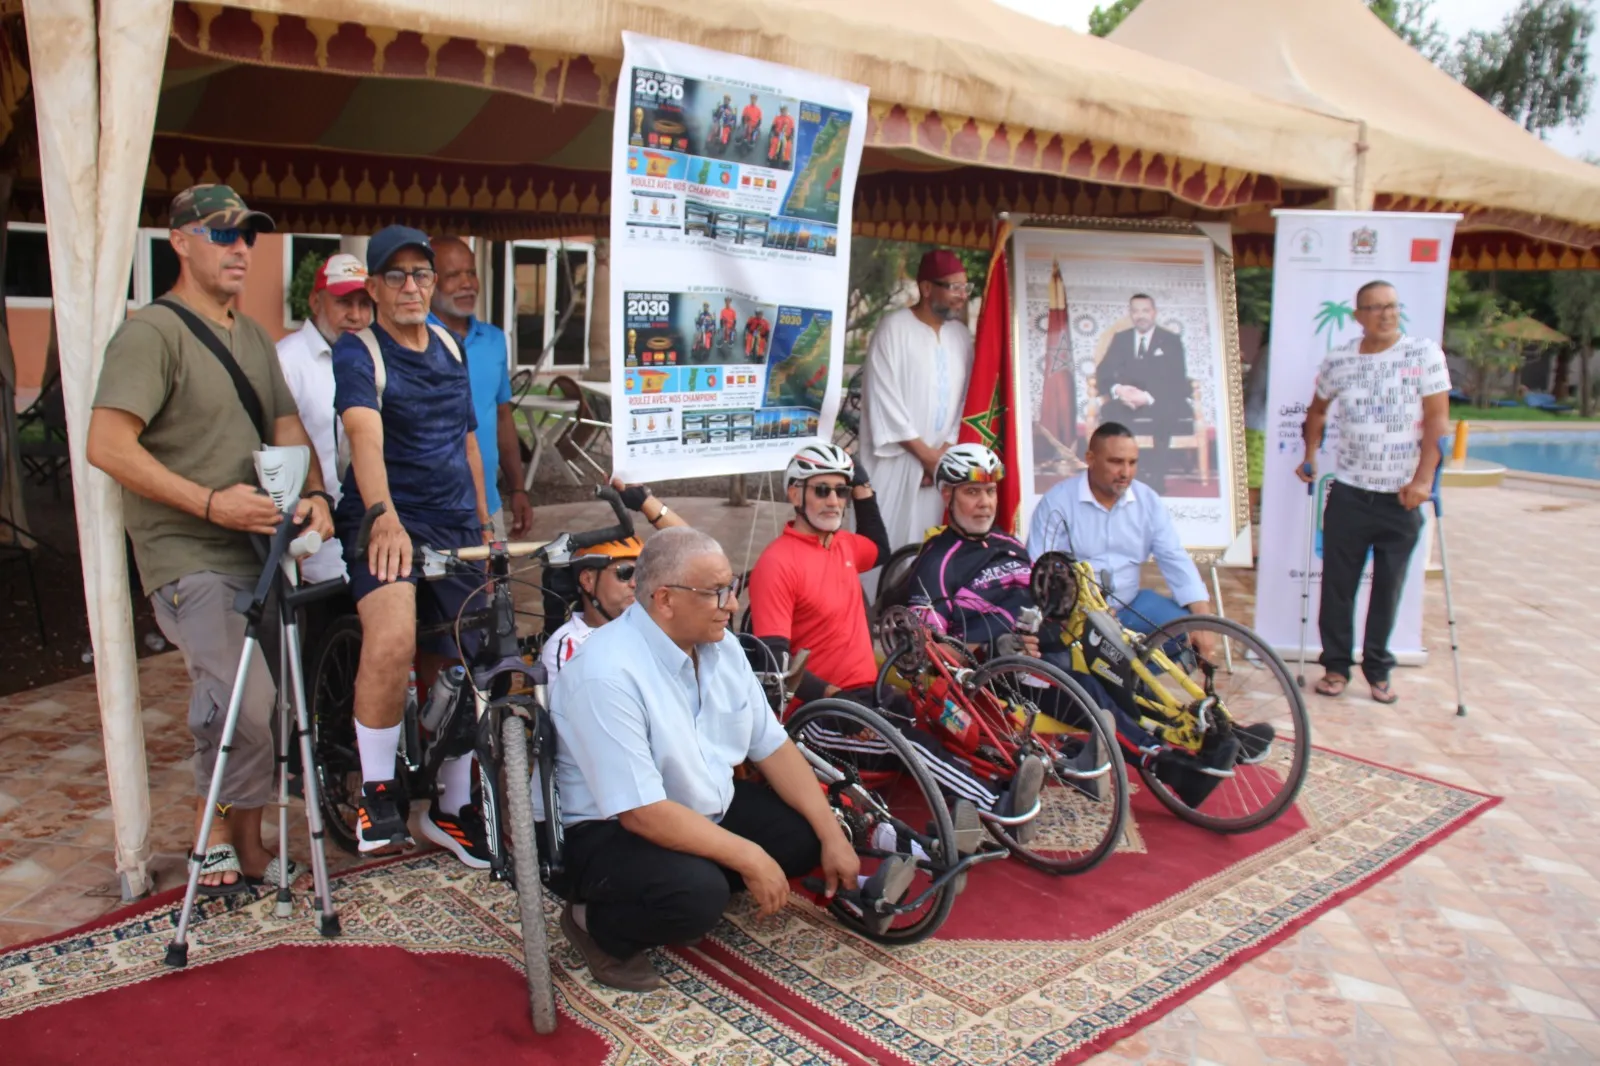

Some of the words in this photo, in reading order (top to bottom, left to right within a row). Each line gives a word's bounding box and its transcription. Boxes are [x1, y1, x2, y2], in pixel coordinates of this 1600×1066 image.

[635, 77, 684, 100] 2030
[631, 176, 656, 188] ROULEZ
[656, 179, 672, 190] AVEC
[673, 180, 686, 191] NOS
[687, 184, 730, 198] CHAMPIONS
[651, 293, 669, 301] MONDE
[628, 300, 670, 316] 2030
[629, 395, 652, 405] ROULEZ
[652, 395, 668, 405] AVEC
[669, 394, 681, 404] NOS
[682, 392, 718, 403] CHAMPIONS
